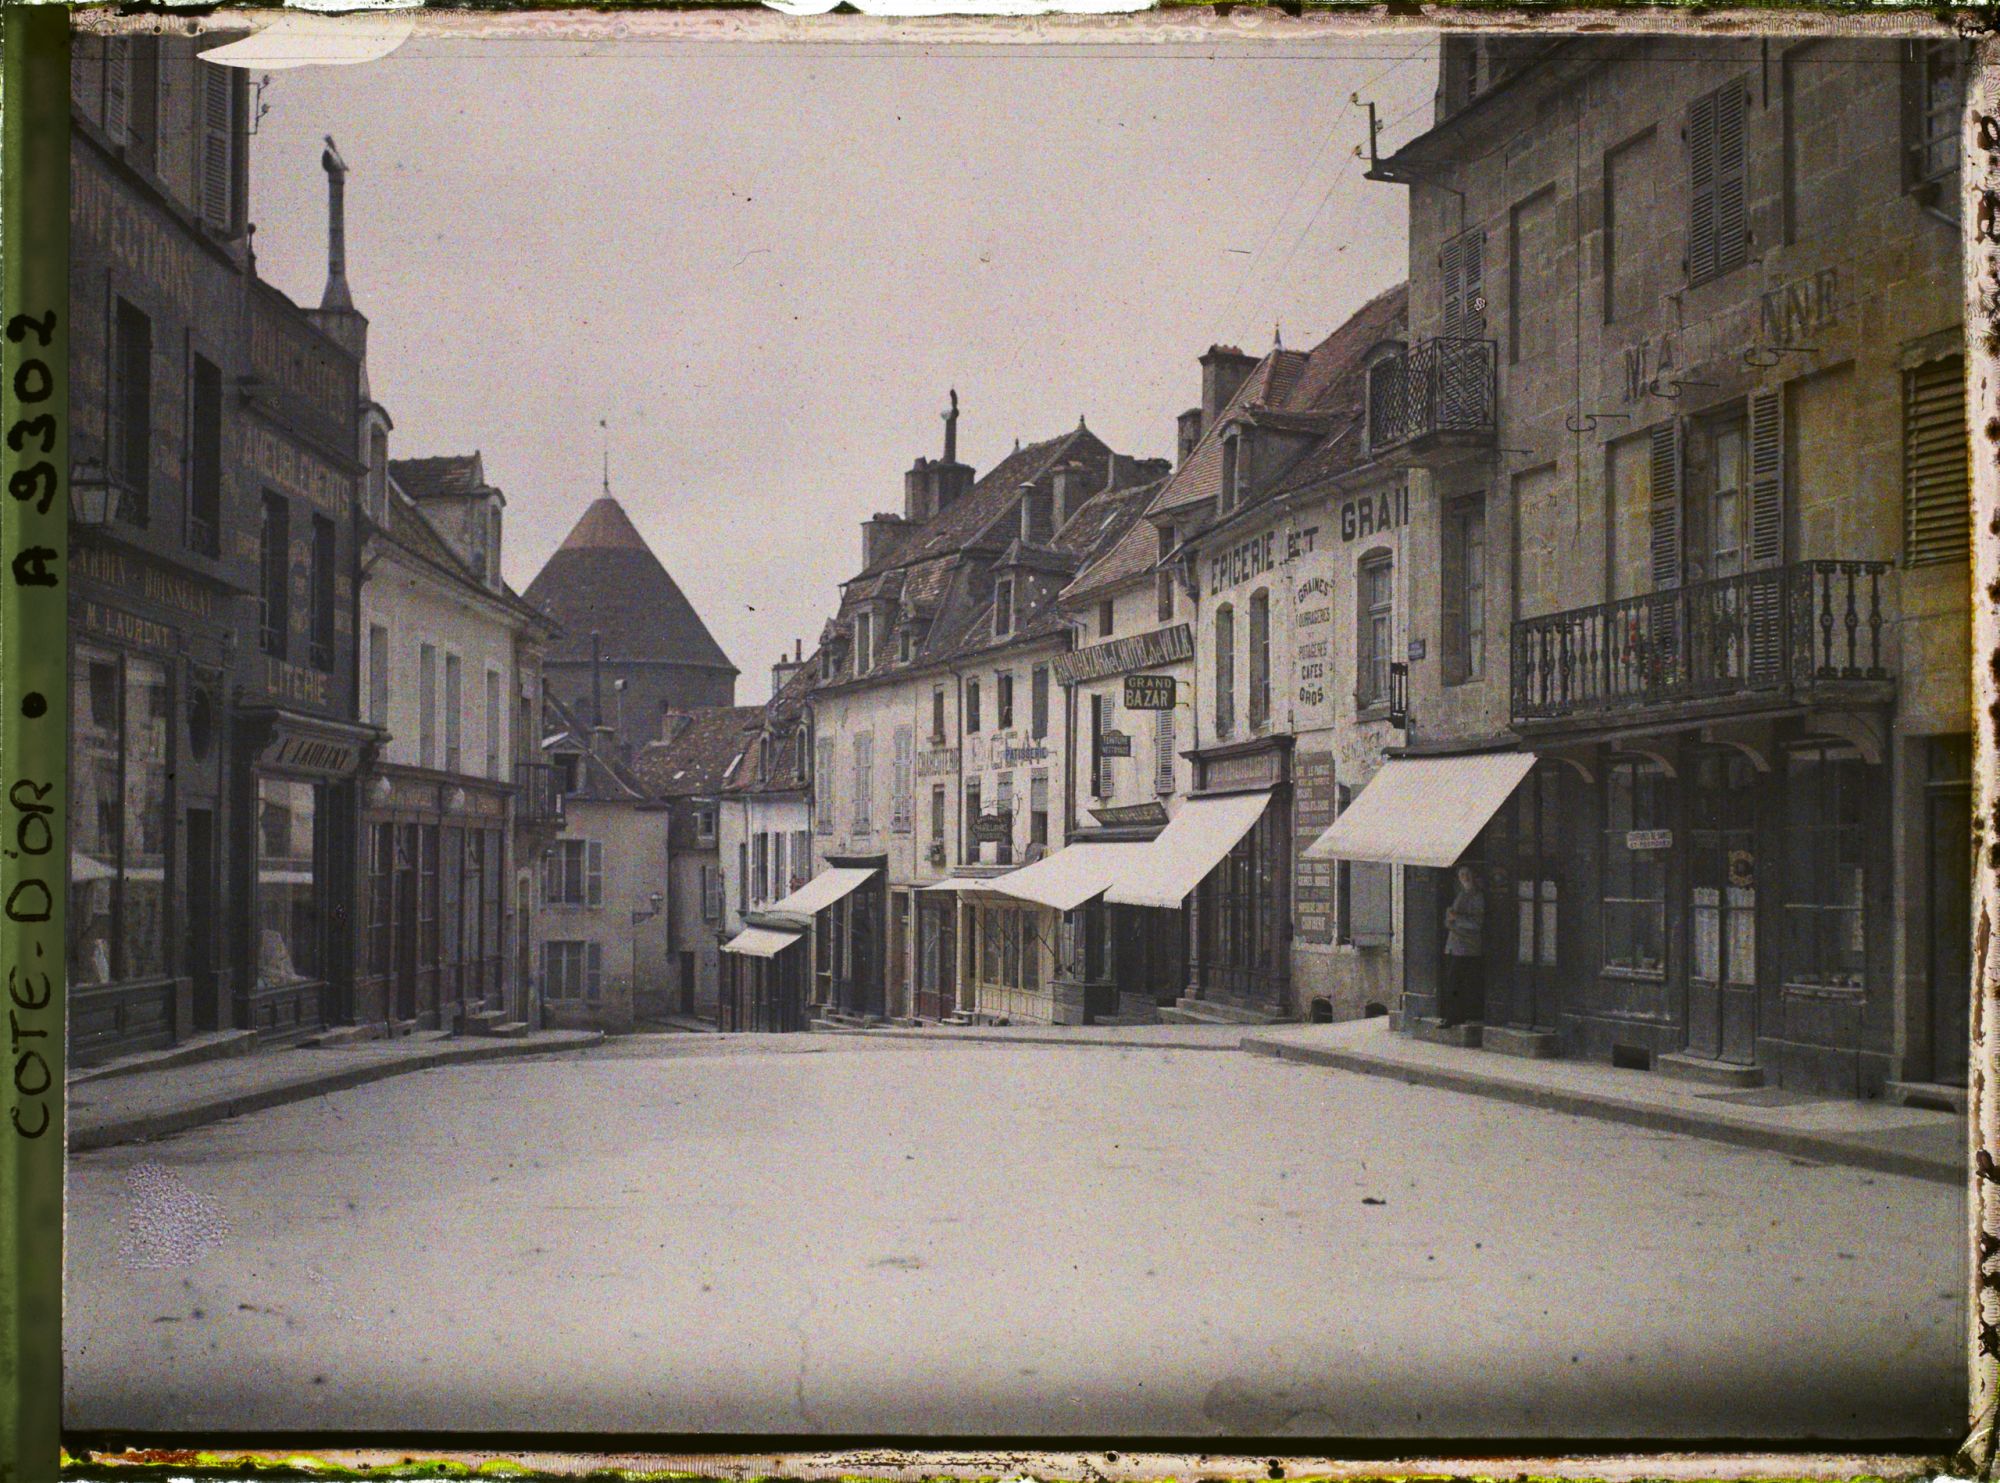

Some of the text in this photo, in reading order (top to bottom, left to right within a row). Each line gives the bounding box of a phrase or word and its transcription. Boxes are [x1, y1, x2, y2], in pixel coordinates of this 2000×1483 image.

[1211, 531, 1275, 596] EPICERIE
[1297, 577, 1330, 604] GRAINES
[104, 609, 172, 650] LAURENT
[267, 657, 328, 706] LITERIE
[1128, 677, 1172, 689] GRAND
[1301, 663, 1324, 681] CAFES
[1126, 690, 1168, 707] BAZAR
[1299, 686, 1325, 706] GROS
